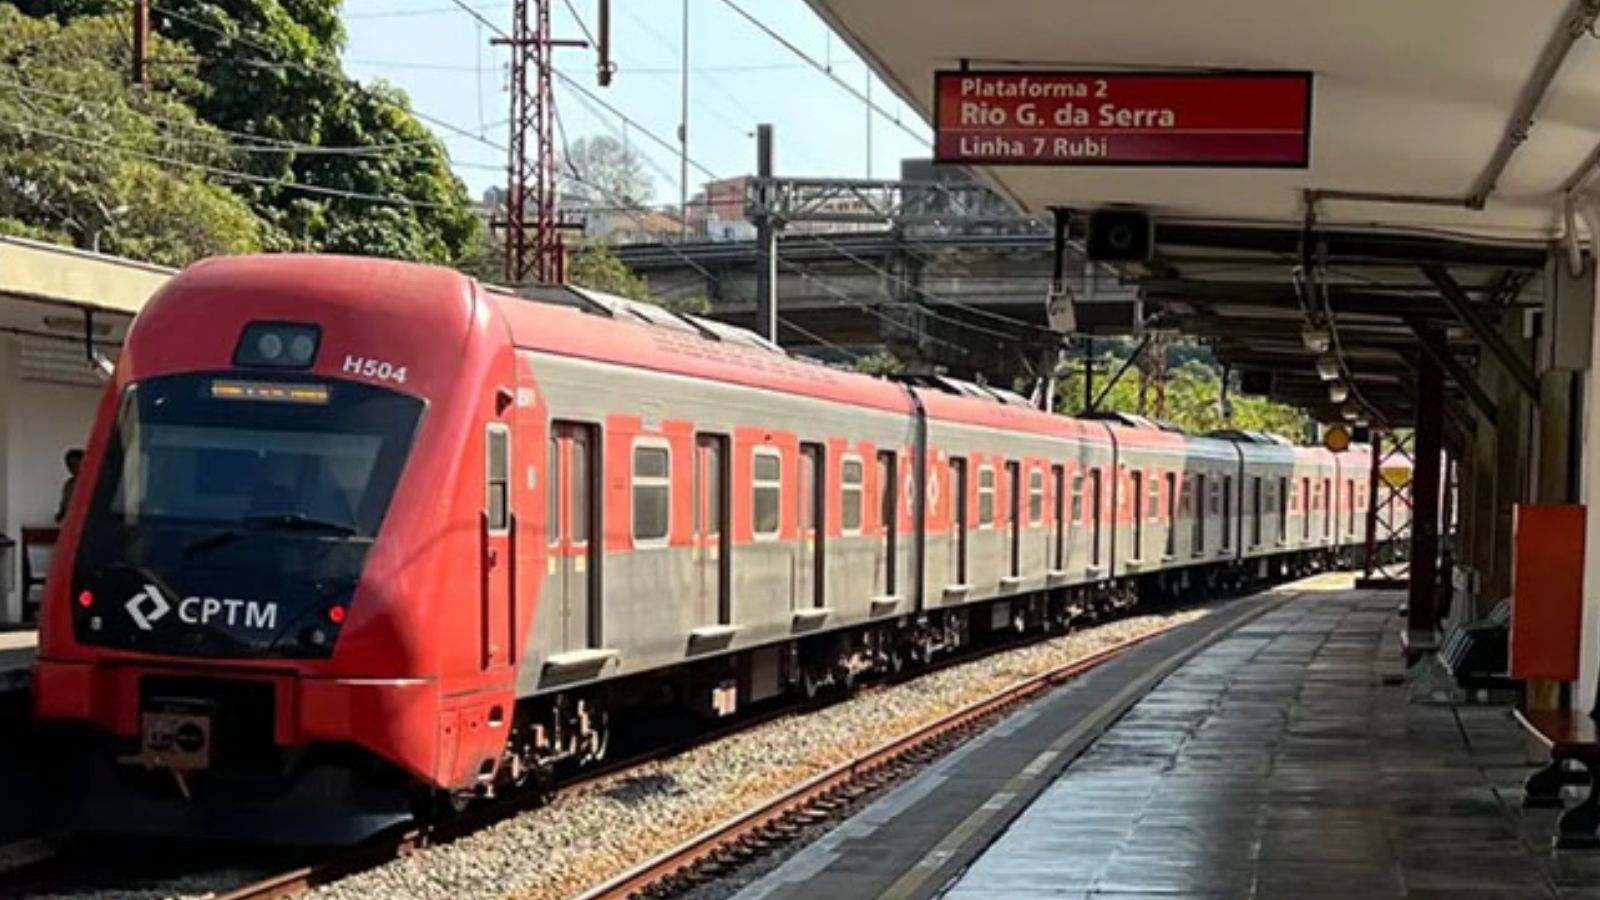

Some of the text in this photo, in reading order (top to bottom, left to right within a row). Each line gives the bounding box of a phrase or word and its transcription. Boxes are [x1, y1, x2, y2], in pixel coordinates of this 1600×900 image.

[961, 78, 1107, 97] Plataforma 2
[961, 103, 1175, 127] Rio G. da Serra
[960, 136, 1107, 157] Linha 7 Rubi
[343, 355, 407, 383] H504
[178, 597, 278, 630] CPTM
